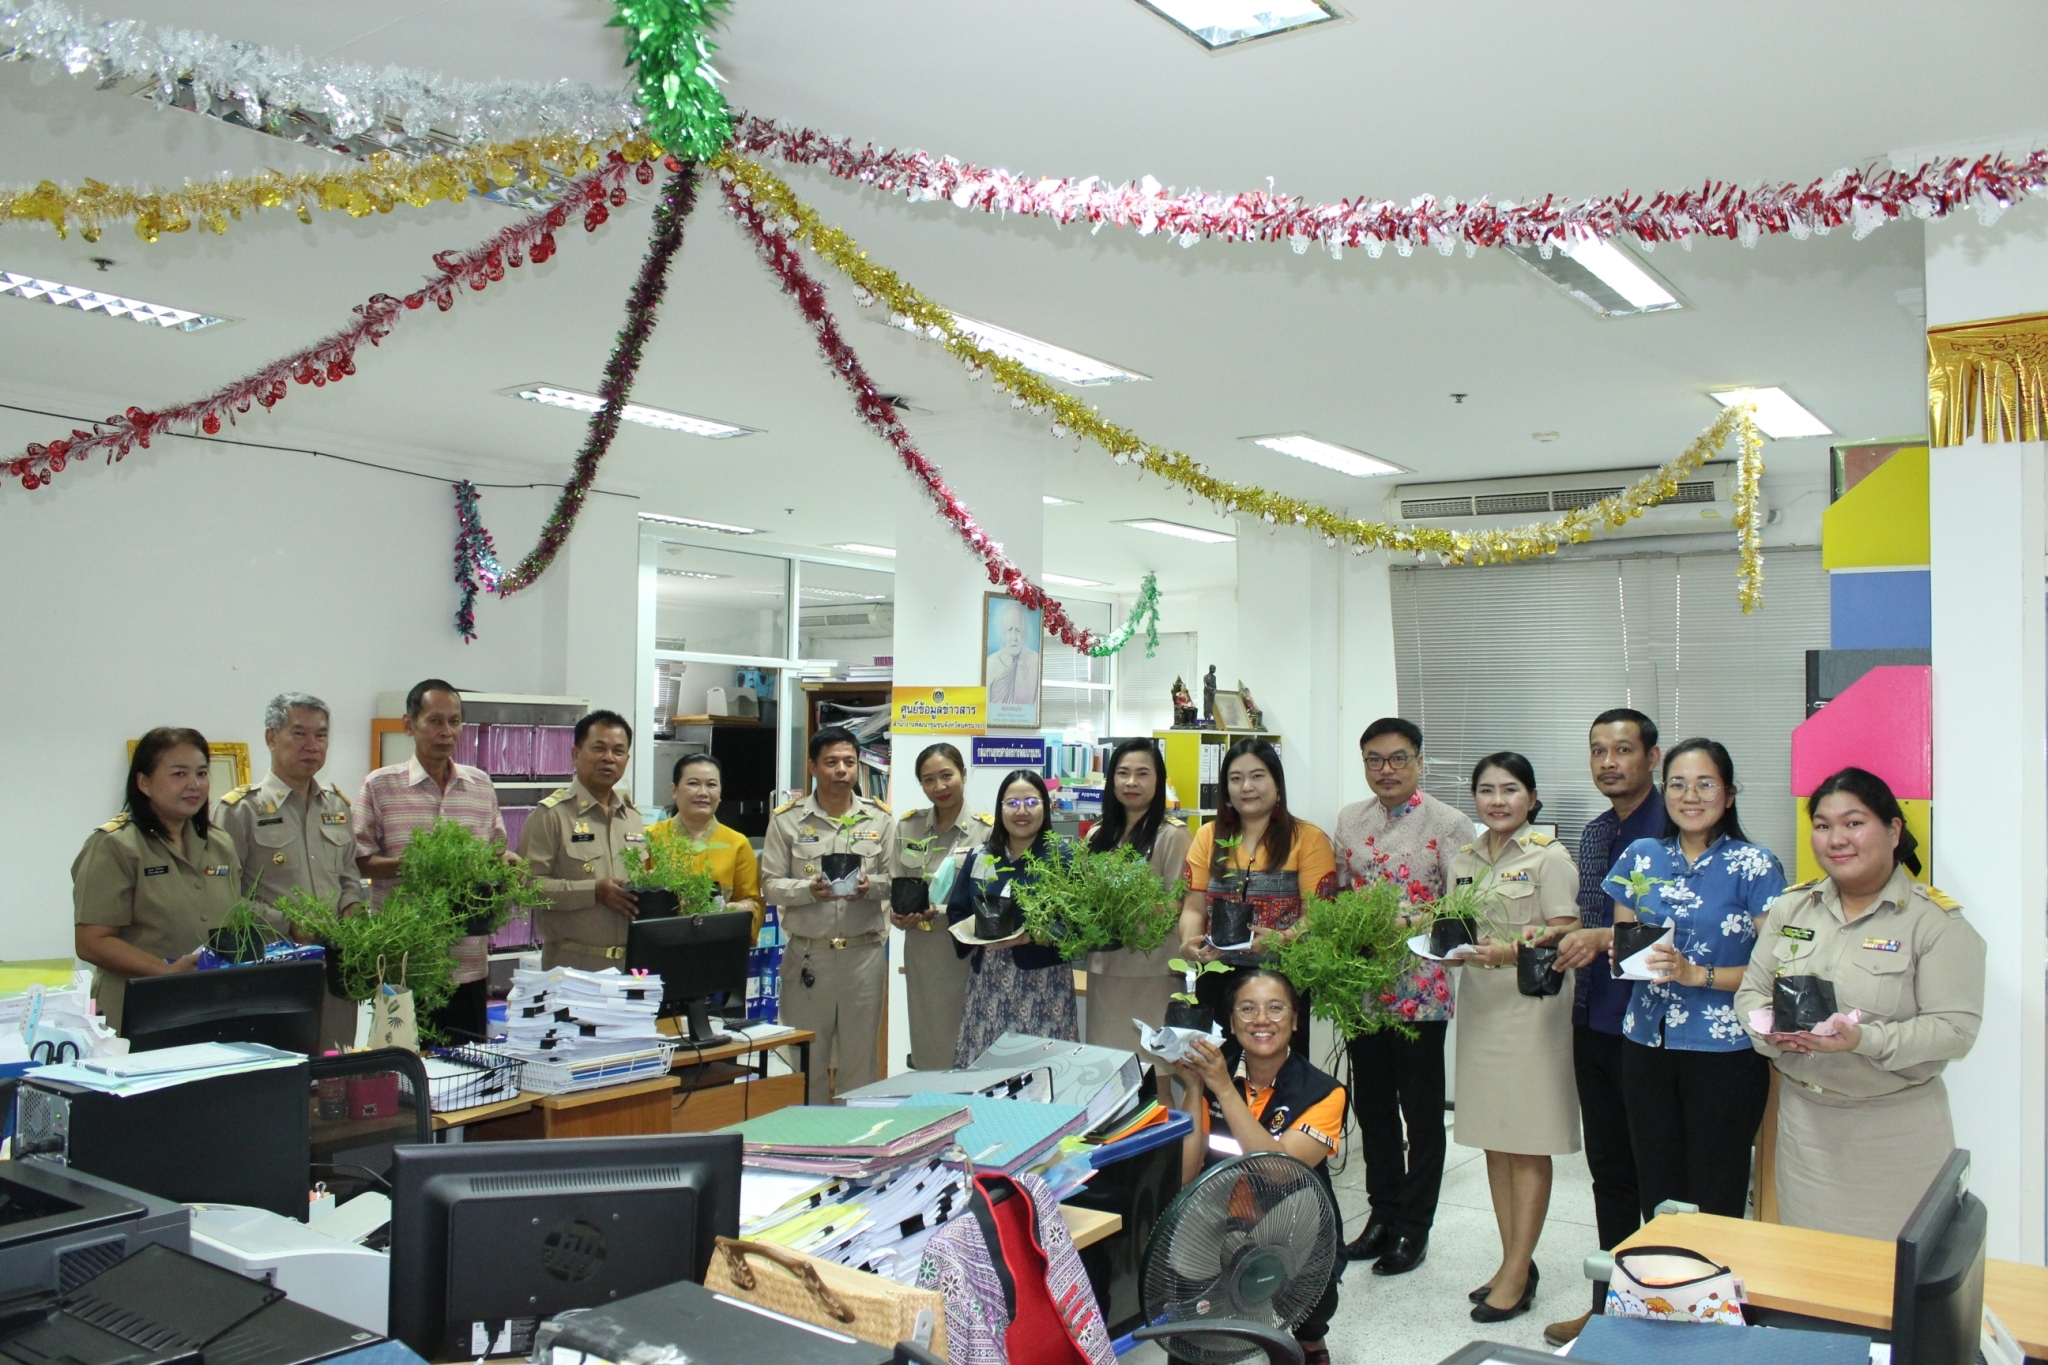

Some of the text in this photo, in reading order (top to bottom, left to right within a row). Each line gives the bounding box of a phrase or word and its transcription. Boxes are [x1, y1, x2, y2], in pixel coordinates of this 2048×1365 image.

[900, 701, 976, 719] ศูนย์ข้อมูลข่าวสาร
